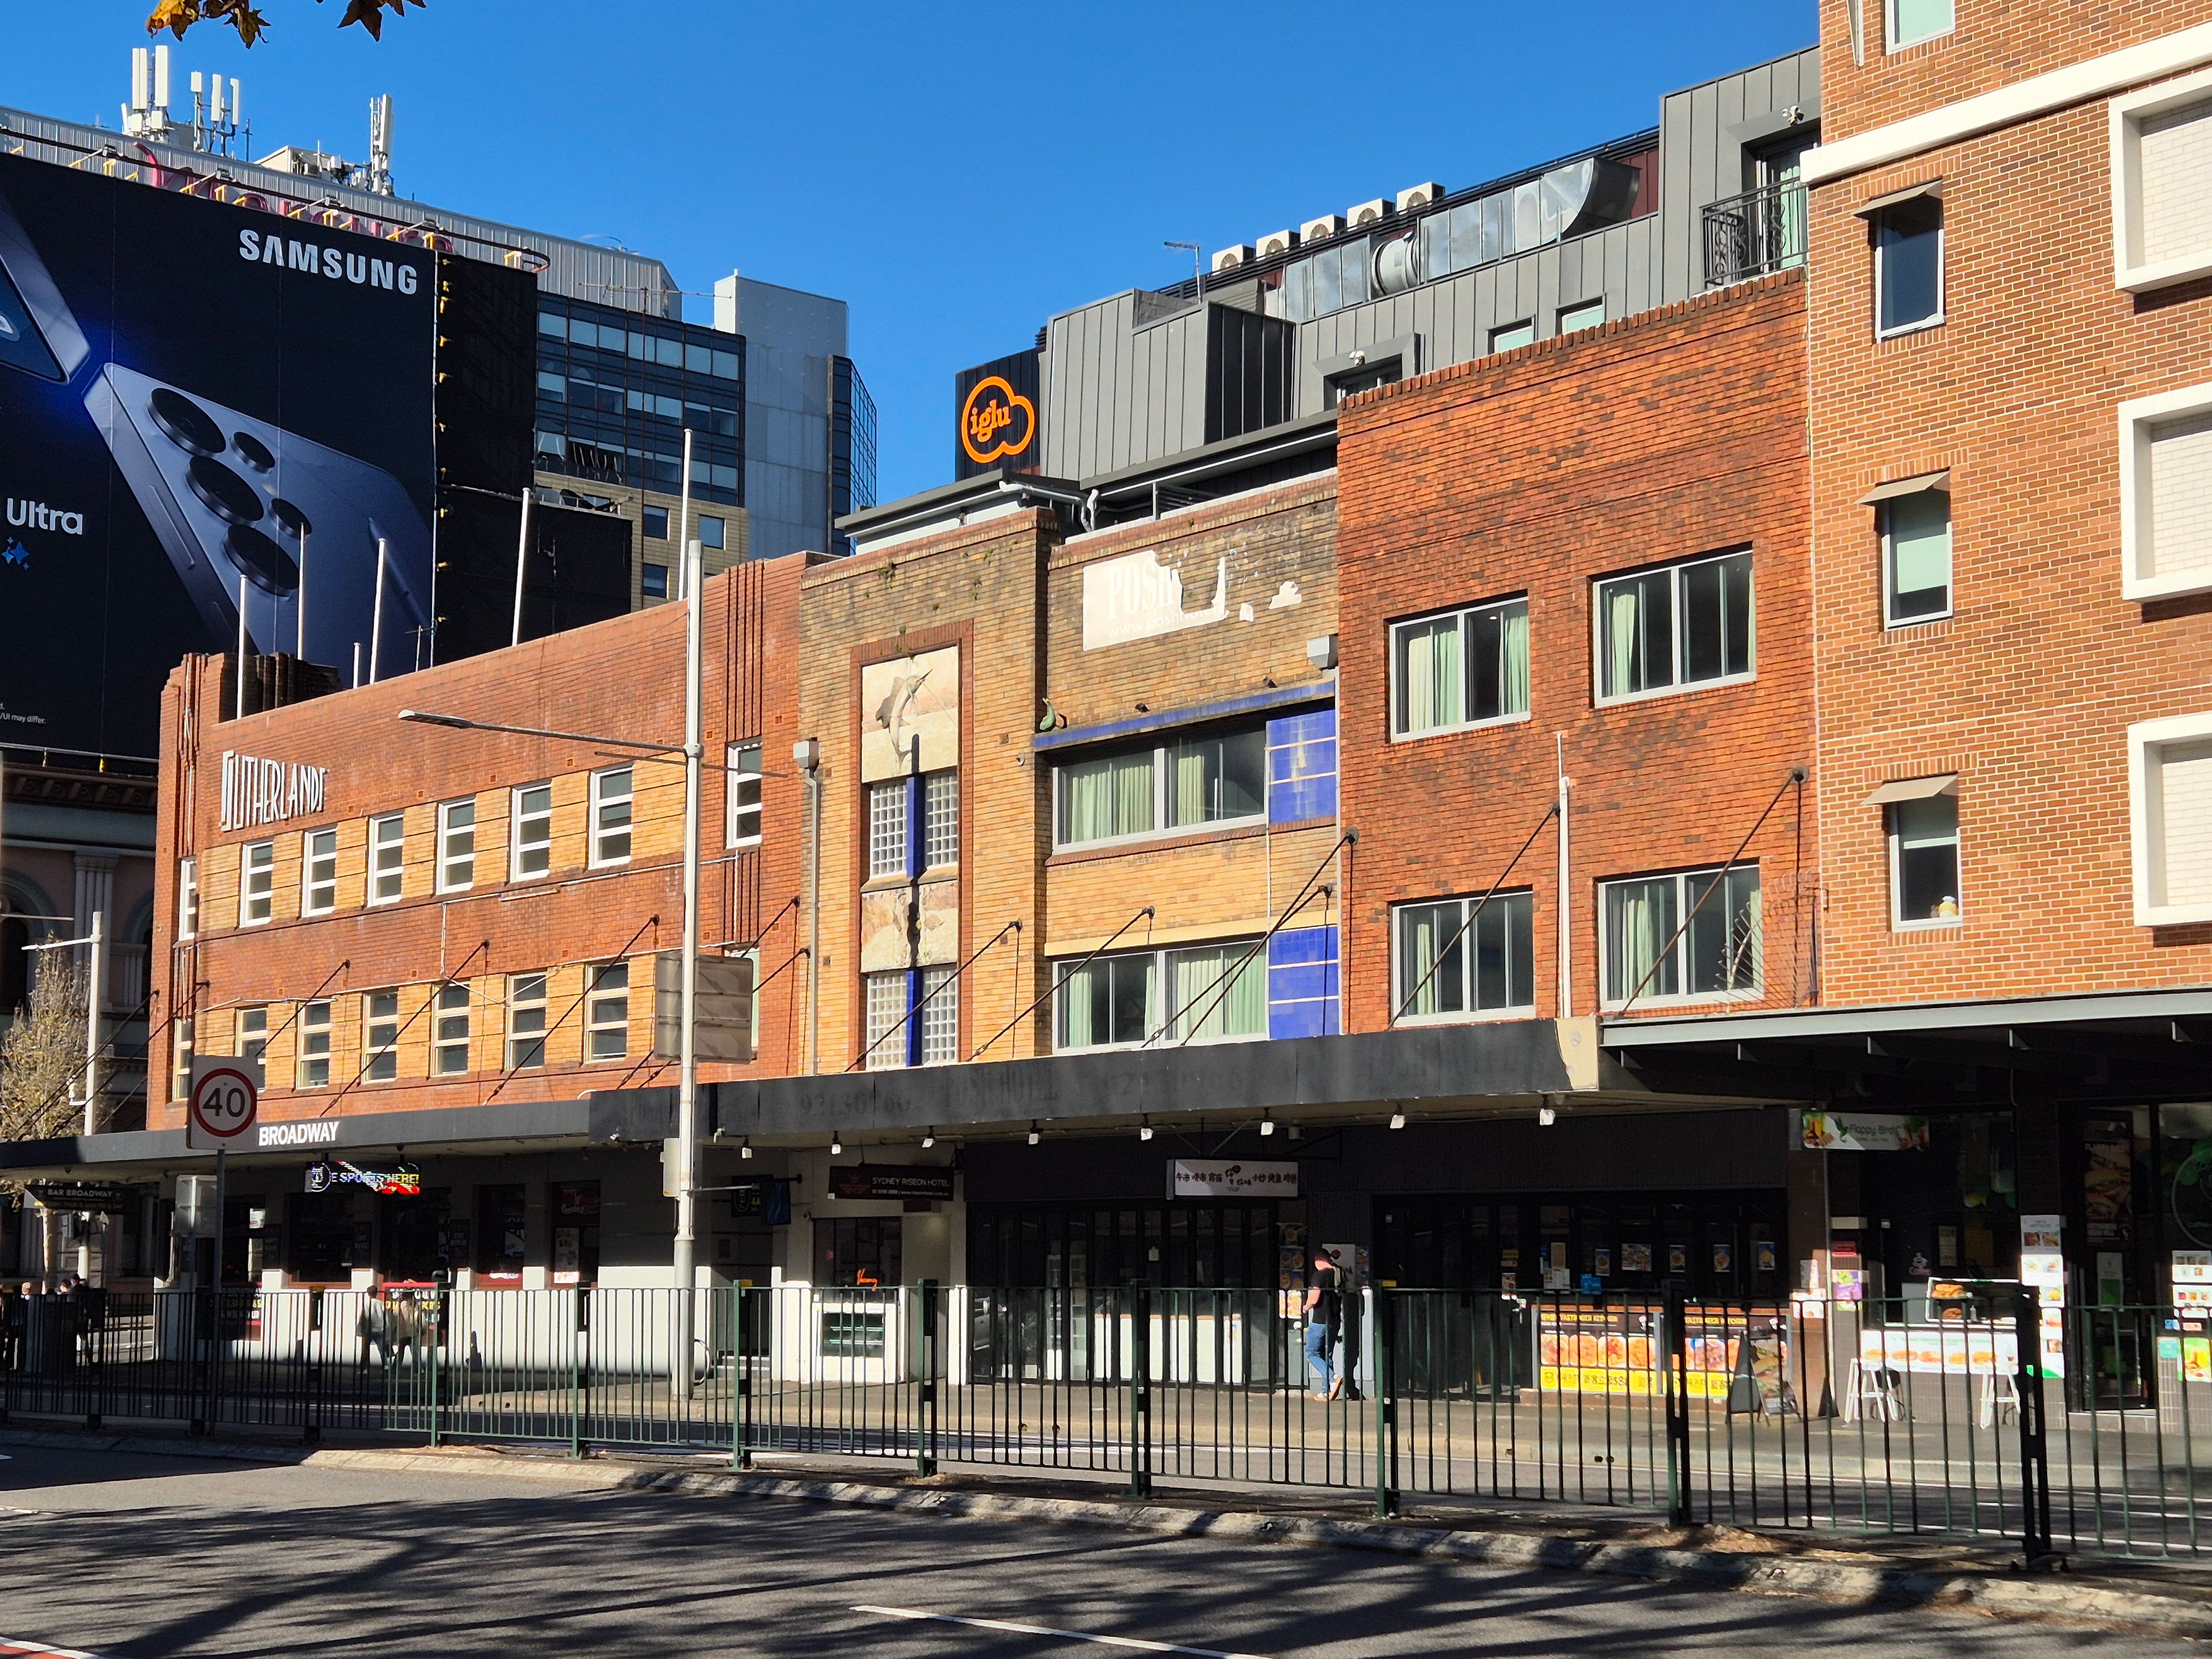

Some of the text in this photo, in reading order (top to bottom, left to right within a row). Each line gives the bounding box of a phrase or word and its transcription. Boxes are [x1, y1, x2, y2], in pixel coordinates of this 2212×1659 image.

[239, 229, 418, 295] SAMSUNG
[970, 399, 1012, 442] iglu
[6, 498, 83, 535] Ultra
[1106, 558, 1174, 620] POSH
[12, 715, 26, 724] may
[202, 1088, 245, 1118] 40
[258, 1121, 340, 1146] BROADWAY
[1878, 1124, 1895, 1135] Bird
[47, 1188, 113, 1198] BAR BROADWAY
[872, 1177, 900, 1185] SYDNEY
[927, 1179, 950, 1187] HOTEL
